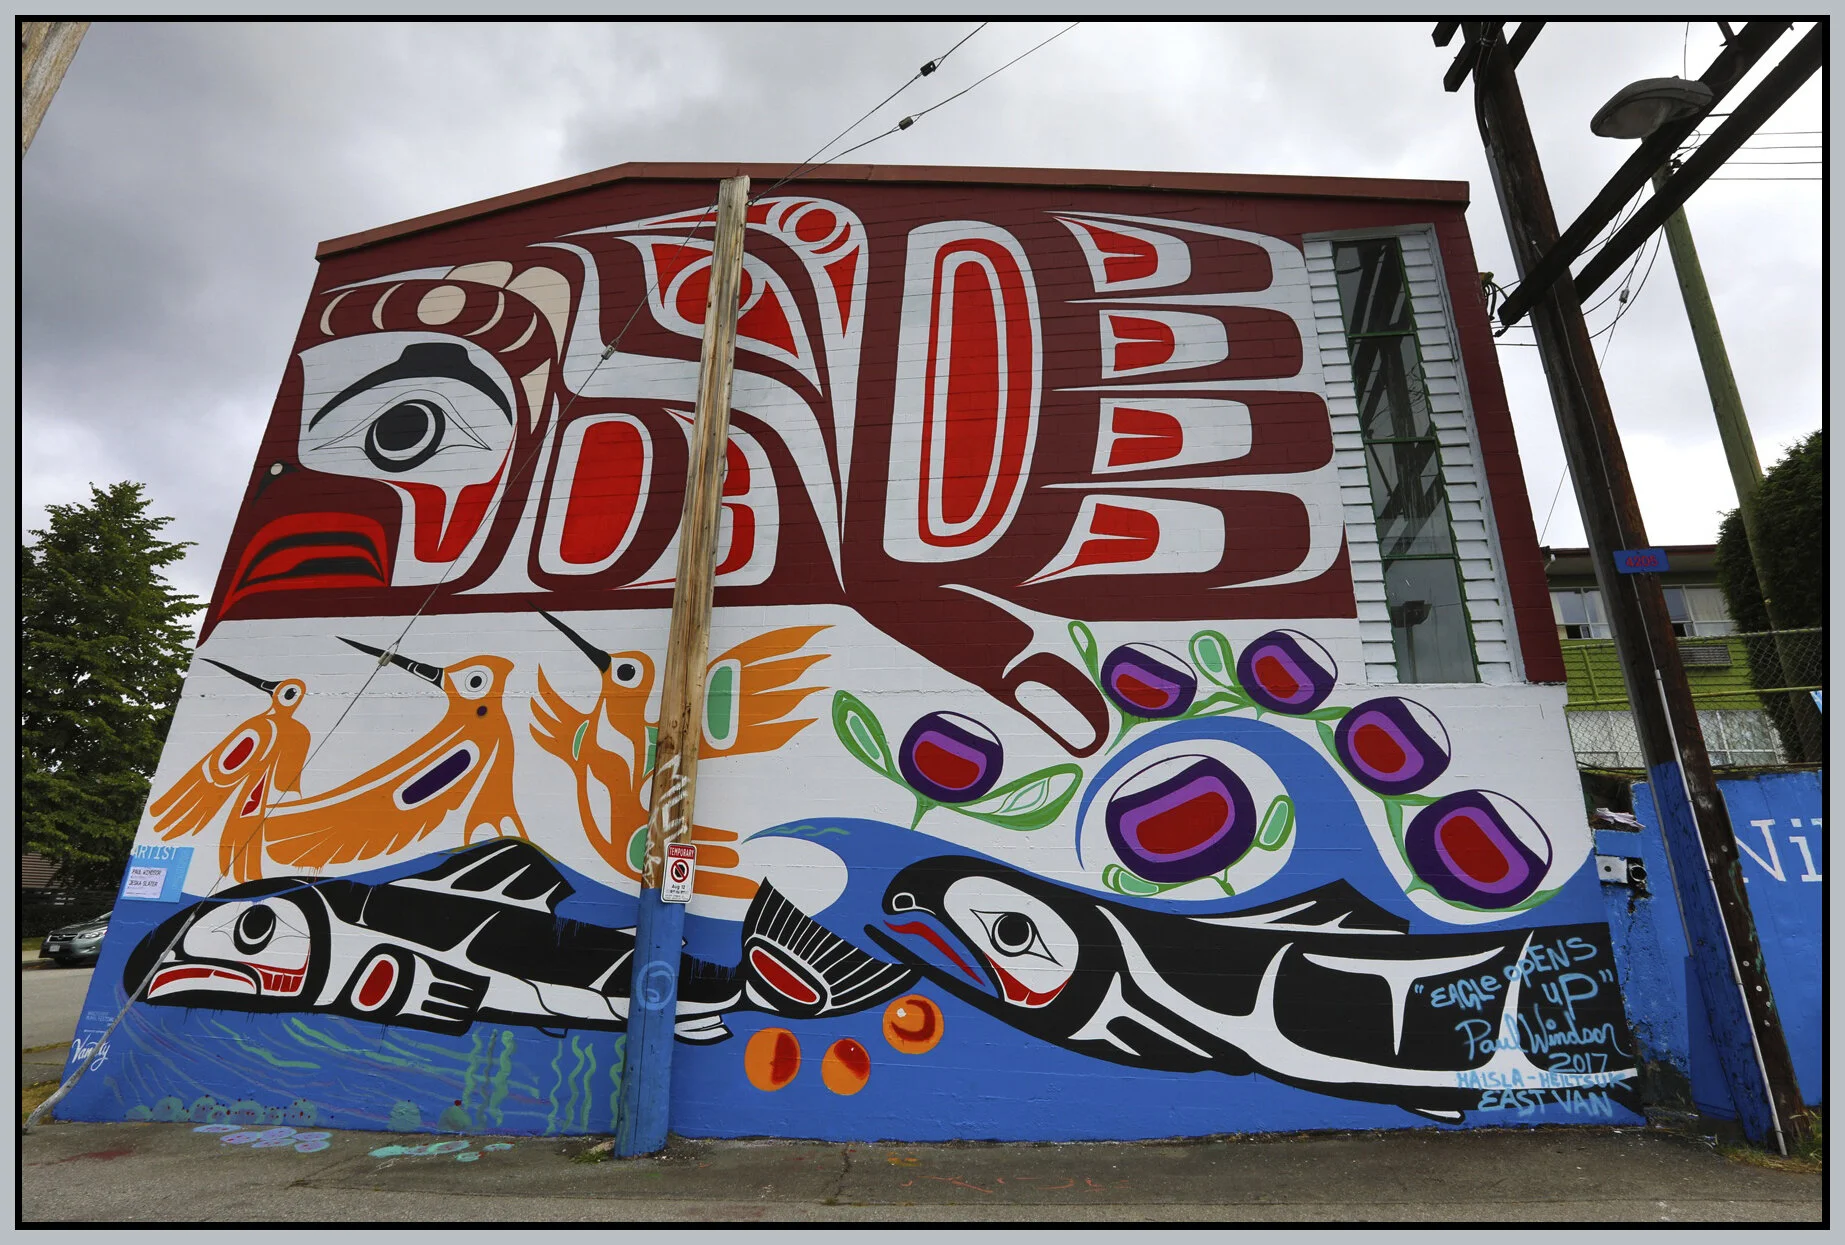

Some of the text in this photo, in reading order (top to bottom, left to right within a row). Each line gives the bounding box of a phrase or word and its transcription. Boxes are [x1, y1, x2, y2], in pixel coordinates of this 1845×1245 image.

[132, 844, 178, 860] ARTIST
[669, 847, 694, 858] TEMPORARY
[1734, 818, 1822, 882] Ni
[1455, 1012, 1528, 1060] Paul
[1548, 1052, 1609, 1074] 2017
[1477, 1088, 1614, 1117] EAST VAN
